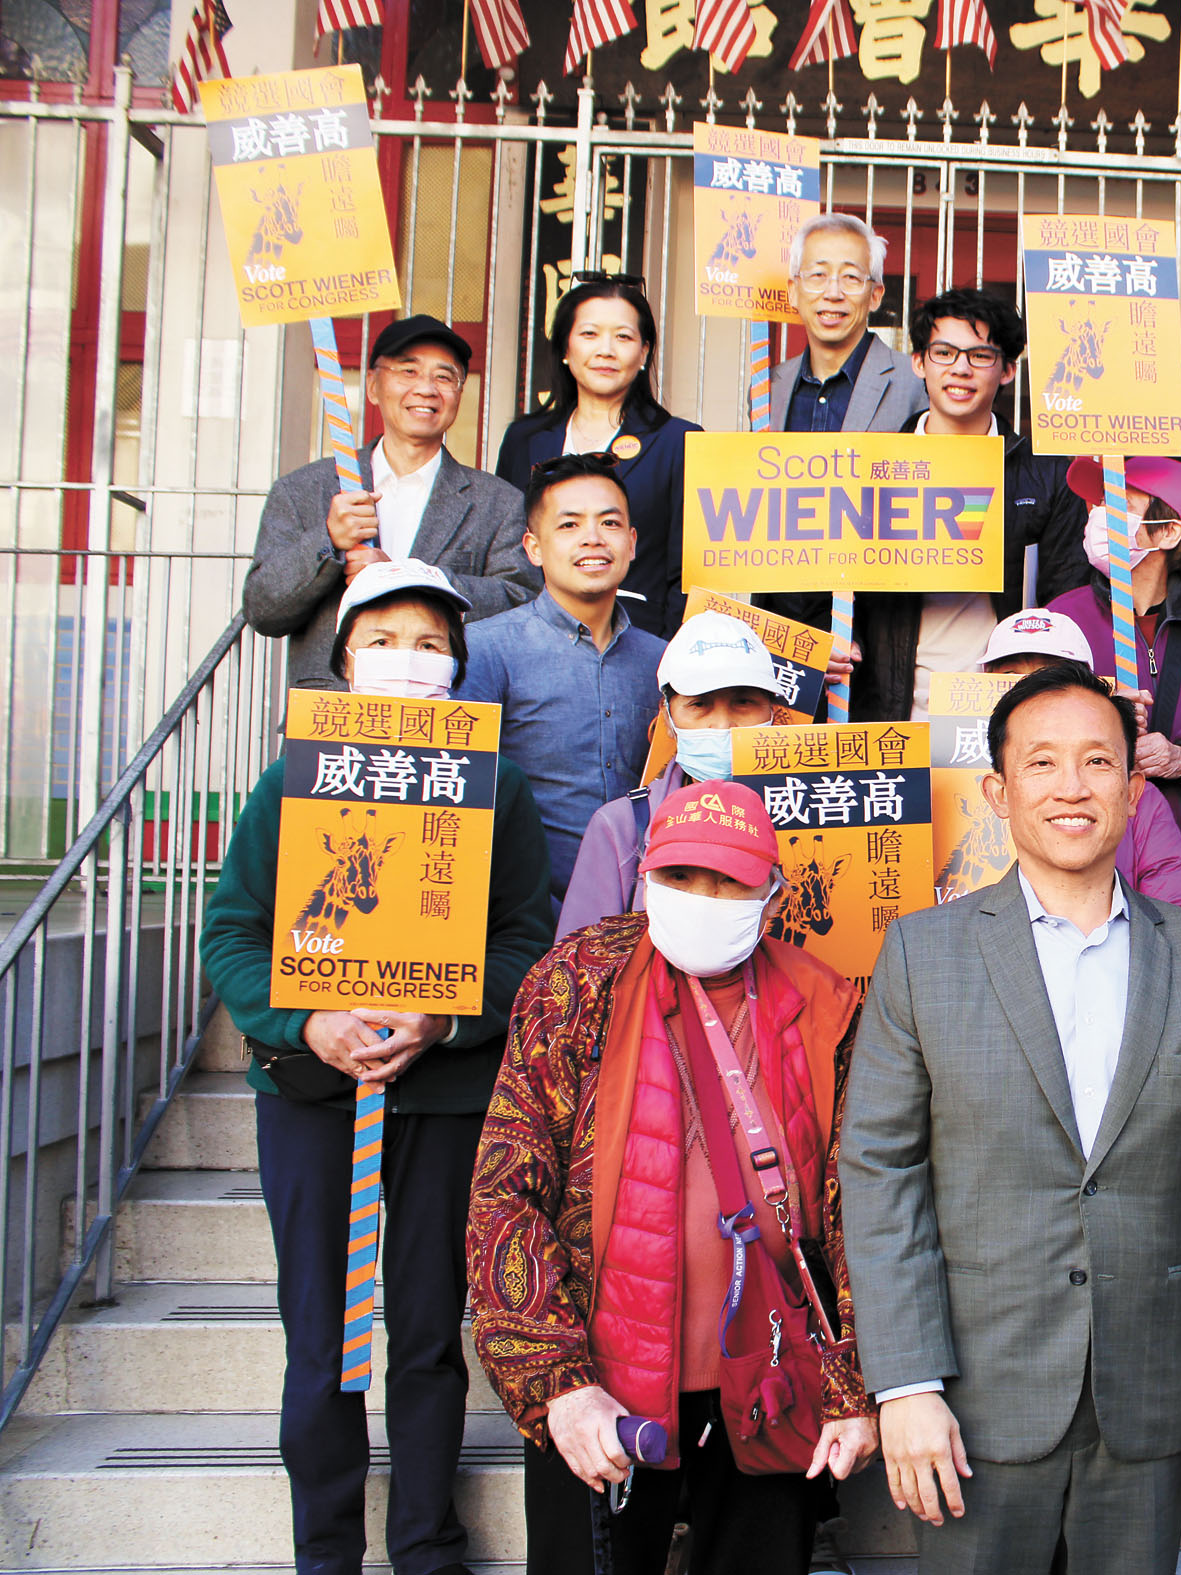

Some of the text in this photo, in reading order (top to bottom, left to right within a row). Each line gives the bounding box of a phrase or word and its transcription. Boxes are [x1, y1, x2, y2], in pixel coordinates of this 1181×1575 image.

[219, 72, 345, 114] 競選國會
[231, 108, 348, 162] 威善高
[848, 142, 1046, 159] THIS DOOR TO REMAIN UNLOCKED DURING BUSINESS HOURS
[710, 156, 804, 198] 威善高
[1039, 218, 1160, 253] 競選國會
[241, 269, 392, 303] SCOTT WIENER
[243, 263, 287, 284] Vote
[705, 266, 739, 283] Vote
[1046, 251, 1158, 296] 威善高
[259, 287, 380, 313] FOR CONGRESS
[700, 283, 790, 302] SCOTT WIE
[712, 297, 799, 315] FOR CONGRES
[1042, 392, 1083, 411] Vote
[1037, 413, 1103, 429] SCOTT
[1053, 430, 1170, 444] FOR CONGRESS
[757, 445, 932, 481] Scott 威善高
[697, 486, 967, 542] WIENER
[703, 547, 984, 568] DEMOCRAT FOR CONGRESS
[773, 660, 806, 706] 高
[308, 696, 480, 748] 競選國會
[752, 726, 911, 773] 競選國會
[310, 744, 471, 804] 威善高
[763, 771, 906, 826] 威善高
[289, 928, 345, 955] Vote
[279, 956, 478, 983] SCOTT WIENER
[298, 979, 457, 1000] FOR CONGRESS
[735, 1247, 744, 1277] ACTION
[732, 1279, 742, 1308] SENIOR
